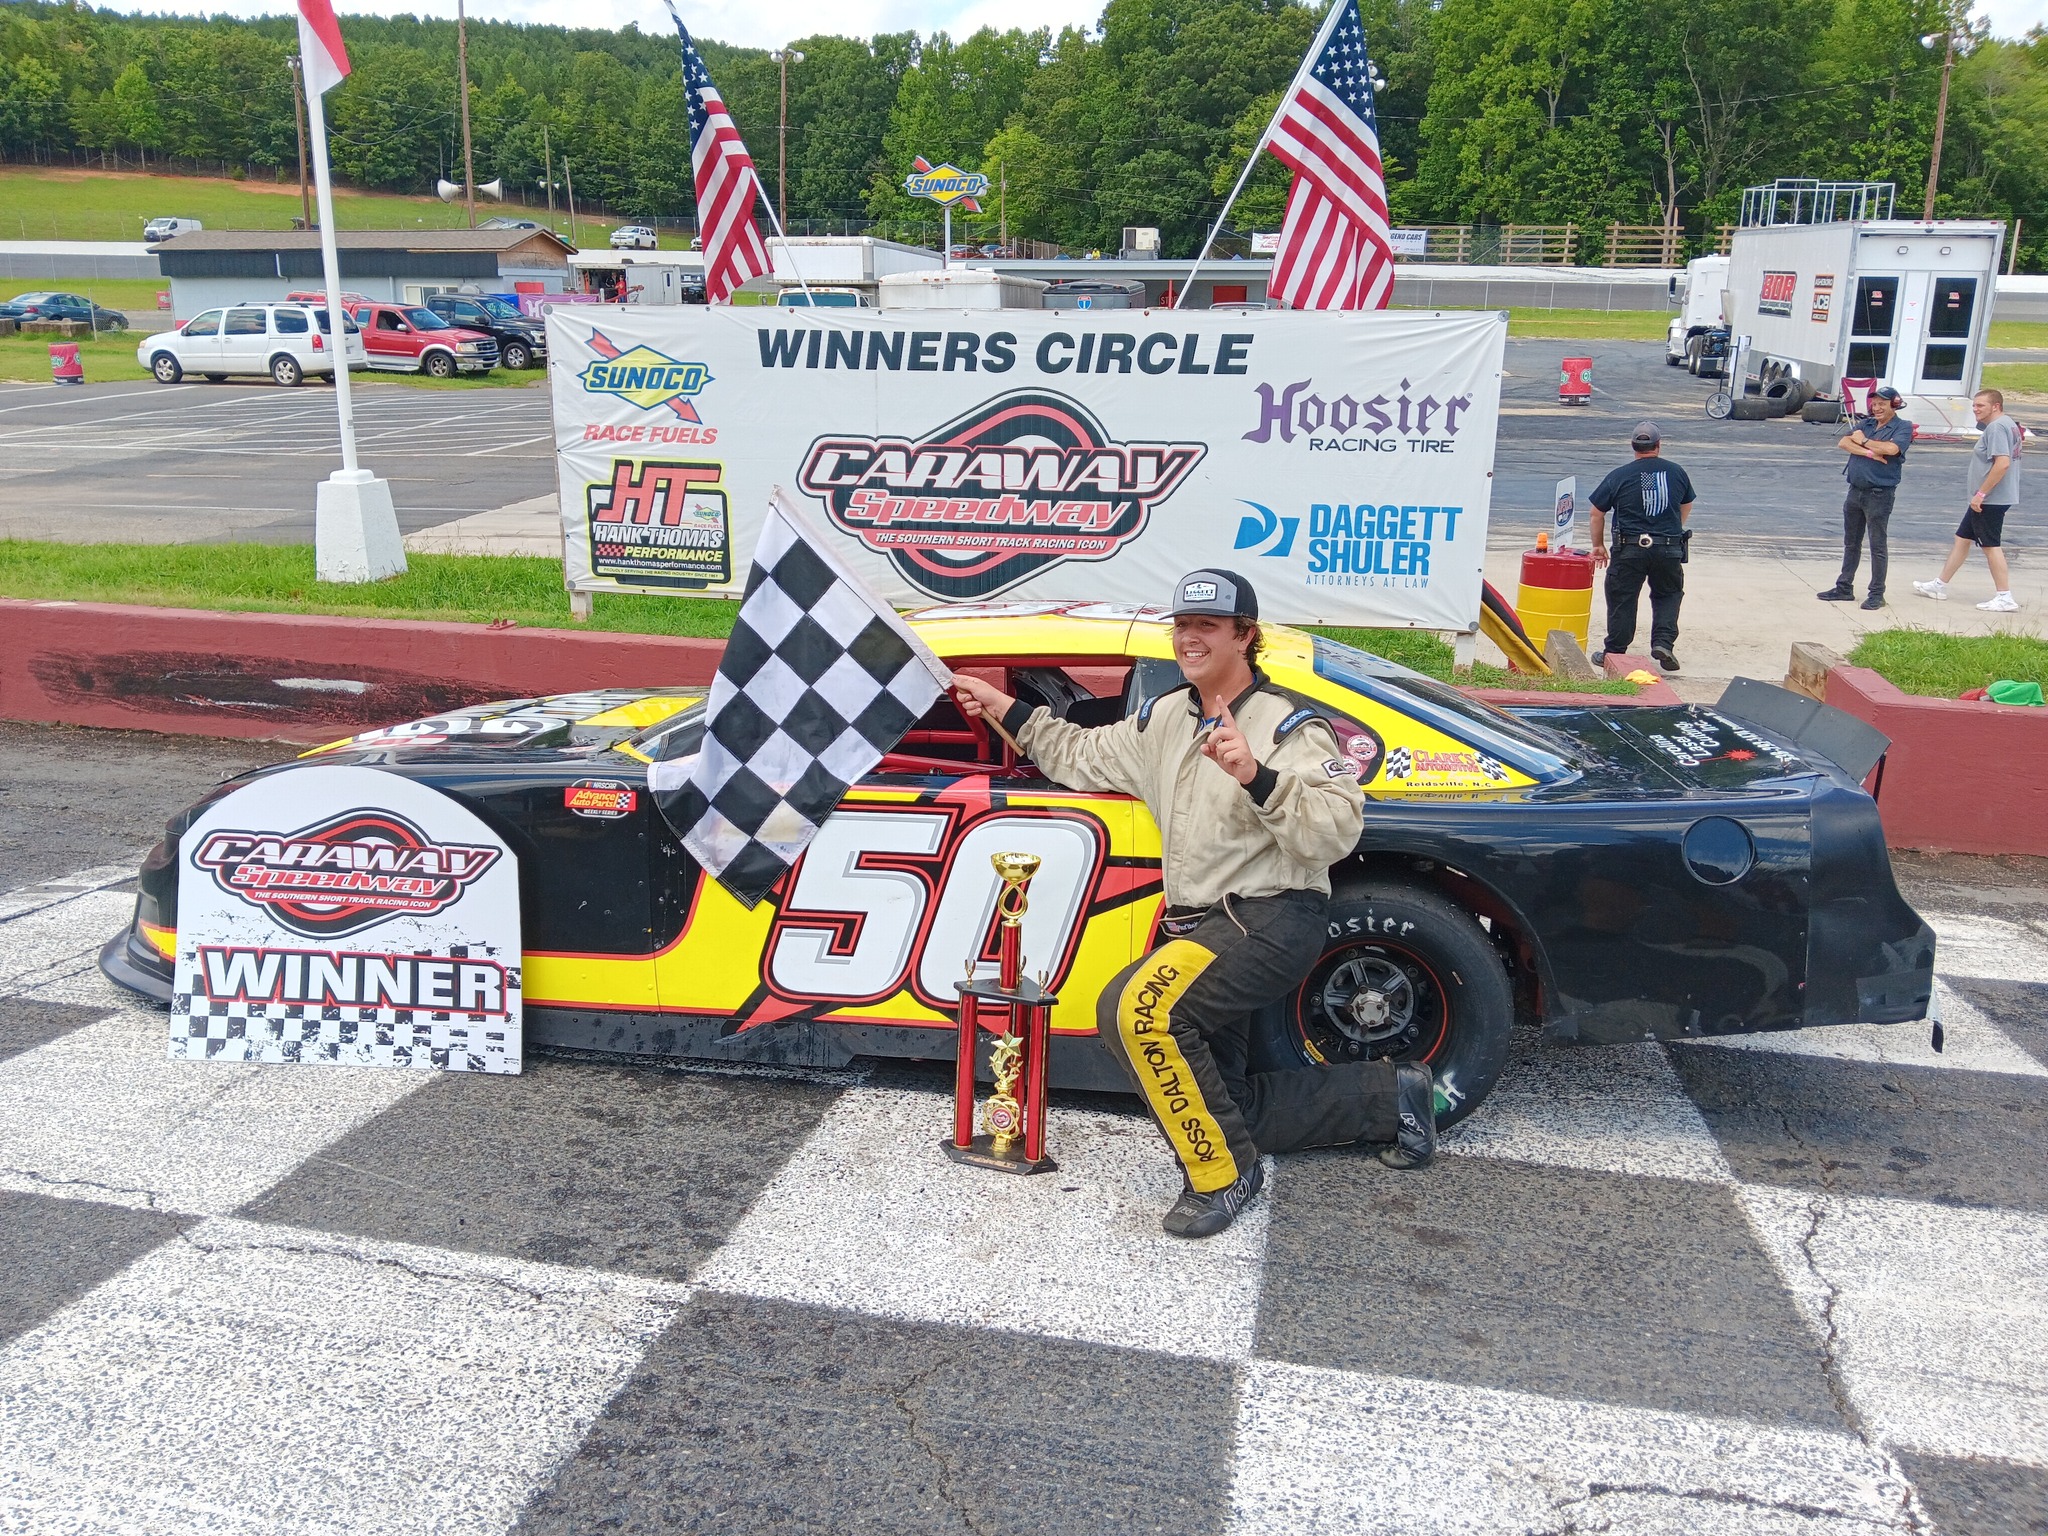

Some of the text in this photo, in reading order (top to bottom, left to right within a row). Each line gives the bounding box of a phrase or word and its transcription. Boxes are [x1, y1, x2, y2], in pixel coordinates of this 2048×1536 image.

[912, 178, 979, 192] SUNOCO
[1406, 233, 1423, 241] CARS
[757, 328, 1255, 375] WINNERS CIRCLE
[589, 365, 703, 390] SUNOCO
[1241, 377, 1472, 444] Hoosier
[583, 424, 719, 445] RACE FUELS
[1309, 438, 1455, 453] RACING TIRE
[809, 448, 1186, 493] CARAWAY
[594, 460, 721, 527] HT
[844, 488, 1132, 533] Speedway
[1309, 504, 1464, 541] DAGGETT
[594, 524, 725, 548] HANK THOMAS
[875, 532, 1107, 550] THE SOUTHERN SHORT TRACK RACING ICON
[598, 558, 722, 571] www.hankthomasperformance.com
[624, 546, 724, 562] PERFORMANCE
[1307, 538, 1431, 576] SHULER
[1305, 574, 1429, 589] ATTORNEYS AT LAW
[1412, 749, 1477, 765] CLARK'S
[1414, 762, 1480, 773] AUTOMOTIVE
[574, 790, 616, 800] Advance
[591, 800, 614, 808] Parts
[203, 838, 484, 875] CARAWAY
[230, 864, 451, 896] Speedway
[254, 891, 270, 900] THE
[271, 892, 317, 901] SOUTHERN
[318, 894, 348, 903] SHORT
[348, 896, 376, 905] TRACK
[376, 899, 408, 907] RACING
[771, 812, 1098, 1003] 50
[1328, 907, 1415, 938] osier
[205, 950, 501, 1012] WINNER
[1134, 964, 1219, 1163] ROSS DALTON RACING
